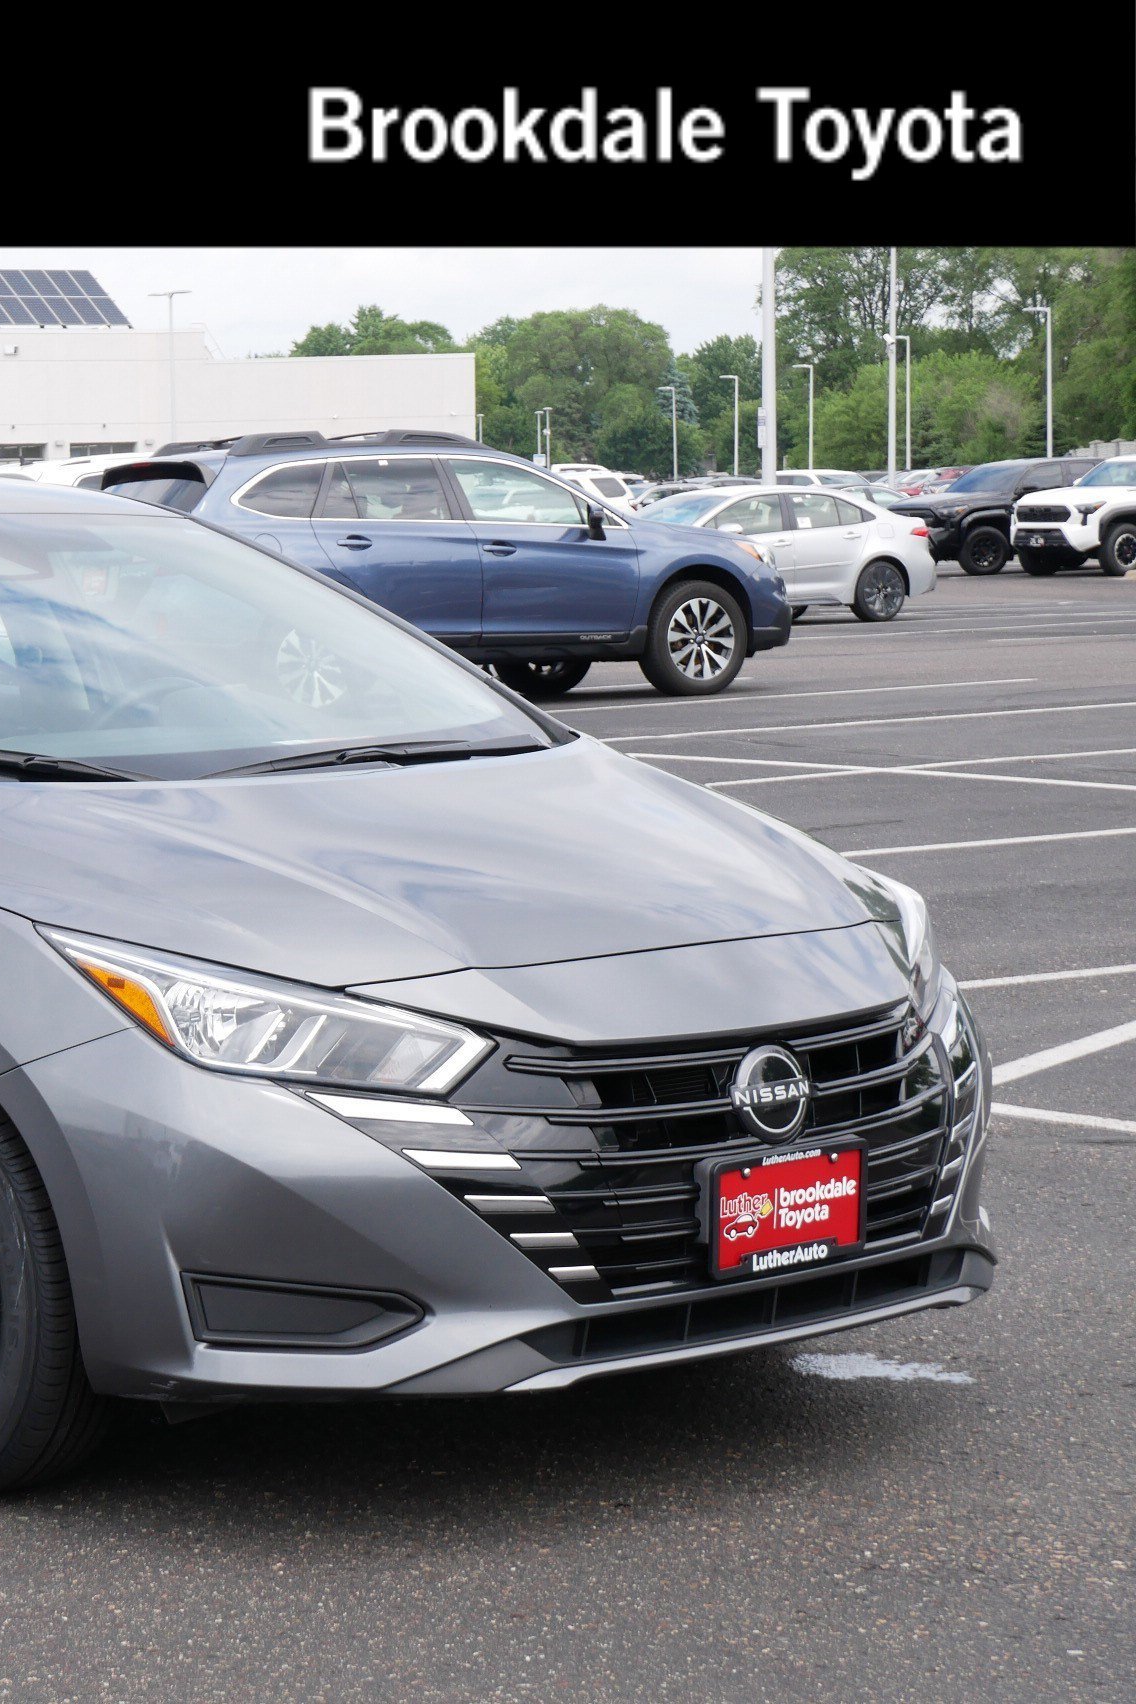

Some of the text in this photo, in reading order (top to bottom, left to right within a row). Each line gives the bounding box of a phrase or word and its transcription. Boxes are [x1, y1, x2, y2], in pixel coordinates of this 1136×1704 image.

[734, 1080, 810, 1105] NISSAN
[762, 1149, 821, 1166] LutherAuto.com
[779, 1176, 857, 1207] brookdale
[720, 1192, 769, 1218] Luther
[778, 1203, 830, 1229] Toyota
[753, 1243, 828, 1272] LutherAuto
